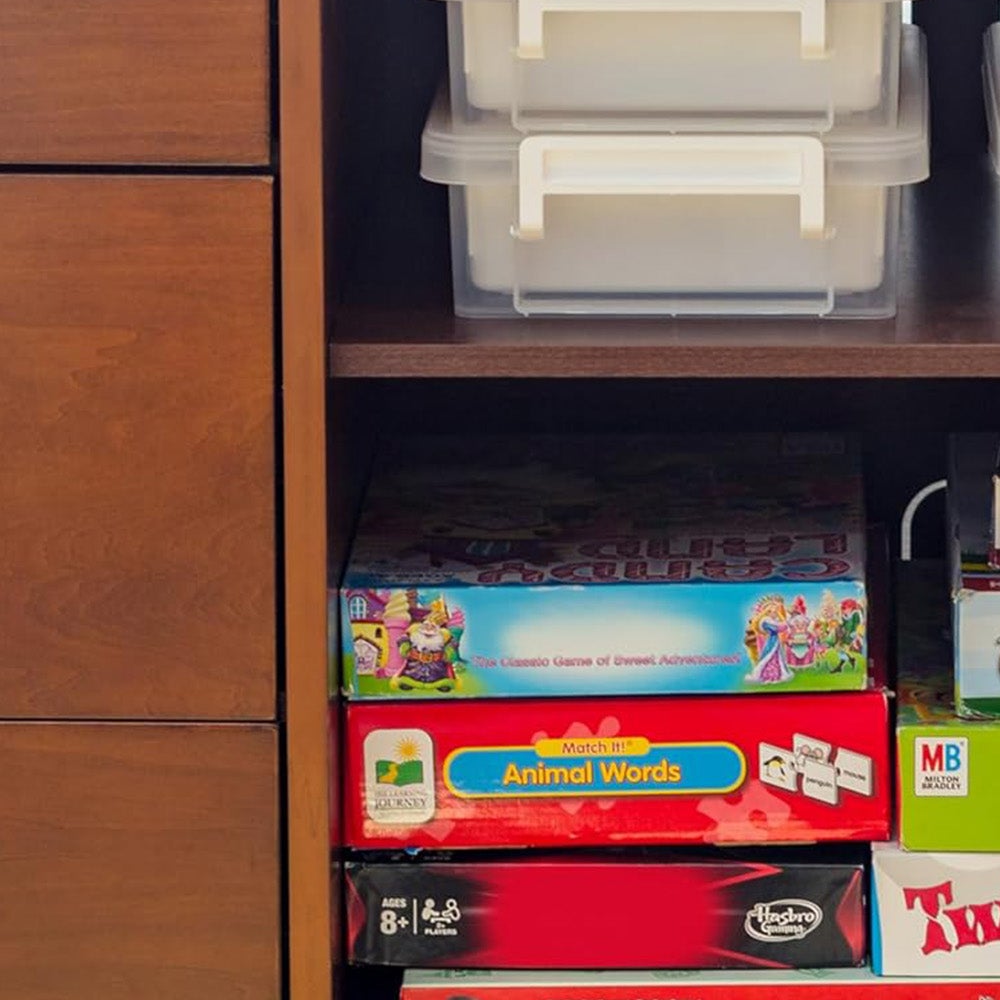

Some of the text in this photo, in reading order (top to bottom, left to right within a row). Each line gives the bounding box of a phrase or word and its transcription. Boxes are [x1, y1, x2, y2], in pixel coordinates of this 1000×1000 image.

[562, 742, 607, 754] Match
[921, 744, 961, 771] MB
[503, 758, 682, 785] Animal Words
[806, 777, 834, 788] penguin
[925, 775, 959, 783] MILTON
[375, 798, 426, 809] JOURNEY
[381, 897, 407, 908] AGES
[752, 905, 815, 925] Hasbro
[380, 909, 409, 935] 8+
